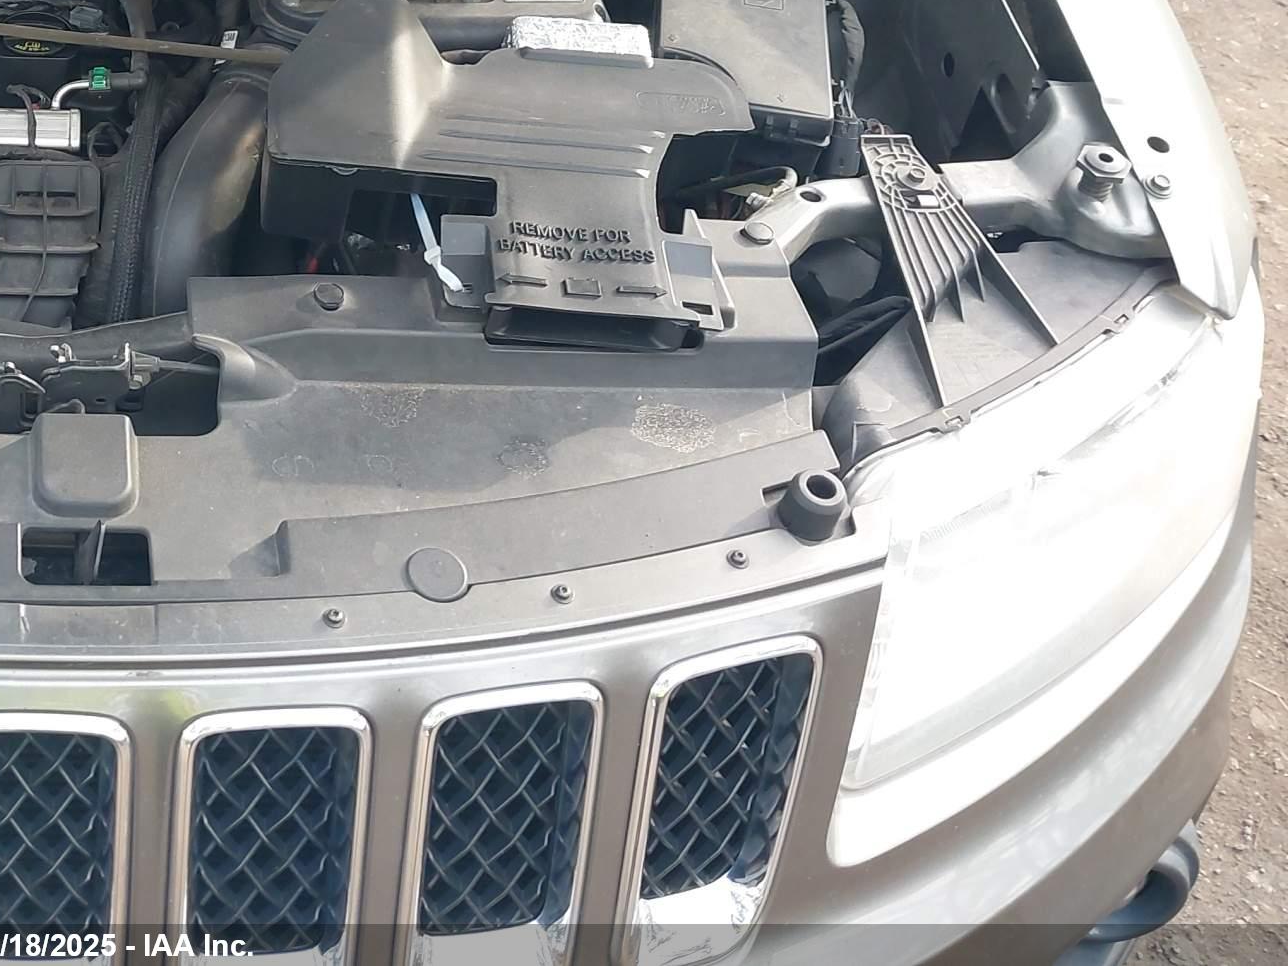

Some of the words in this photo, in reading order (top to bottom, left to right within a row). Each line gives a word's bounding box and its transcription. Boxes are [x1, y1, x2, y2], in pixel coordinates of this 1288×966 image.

[510, 221, 588, 242] REMOVE
[594, 228, 631, 243] FOR
[497, 239, 575, 261] BATTERY
[582, 248, 656, 263] ACCESS
